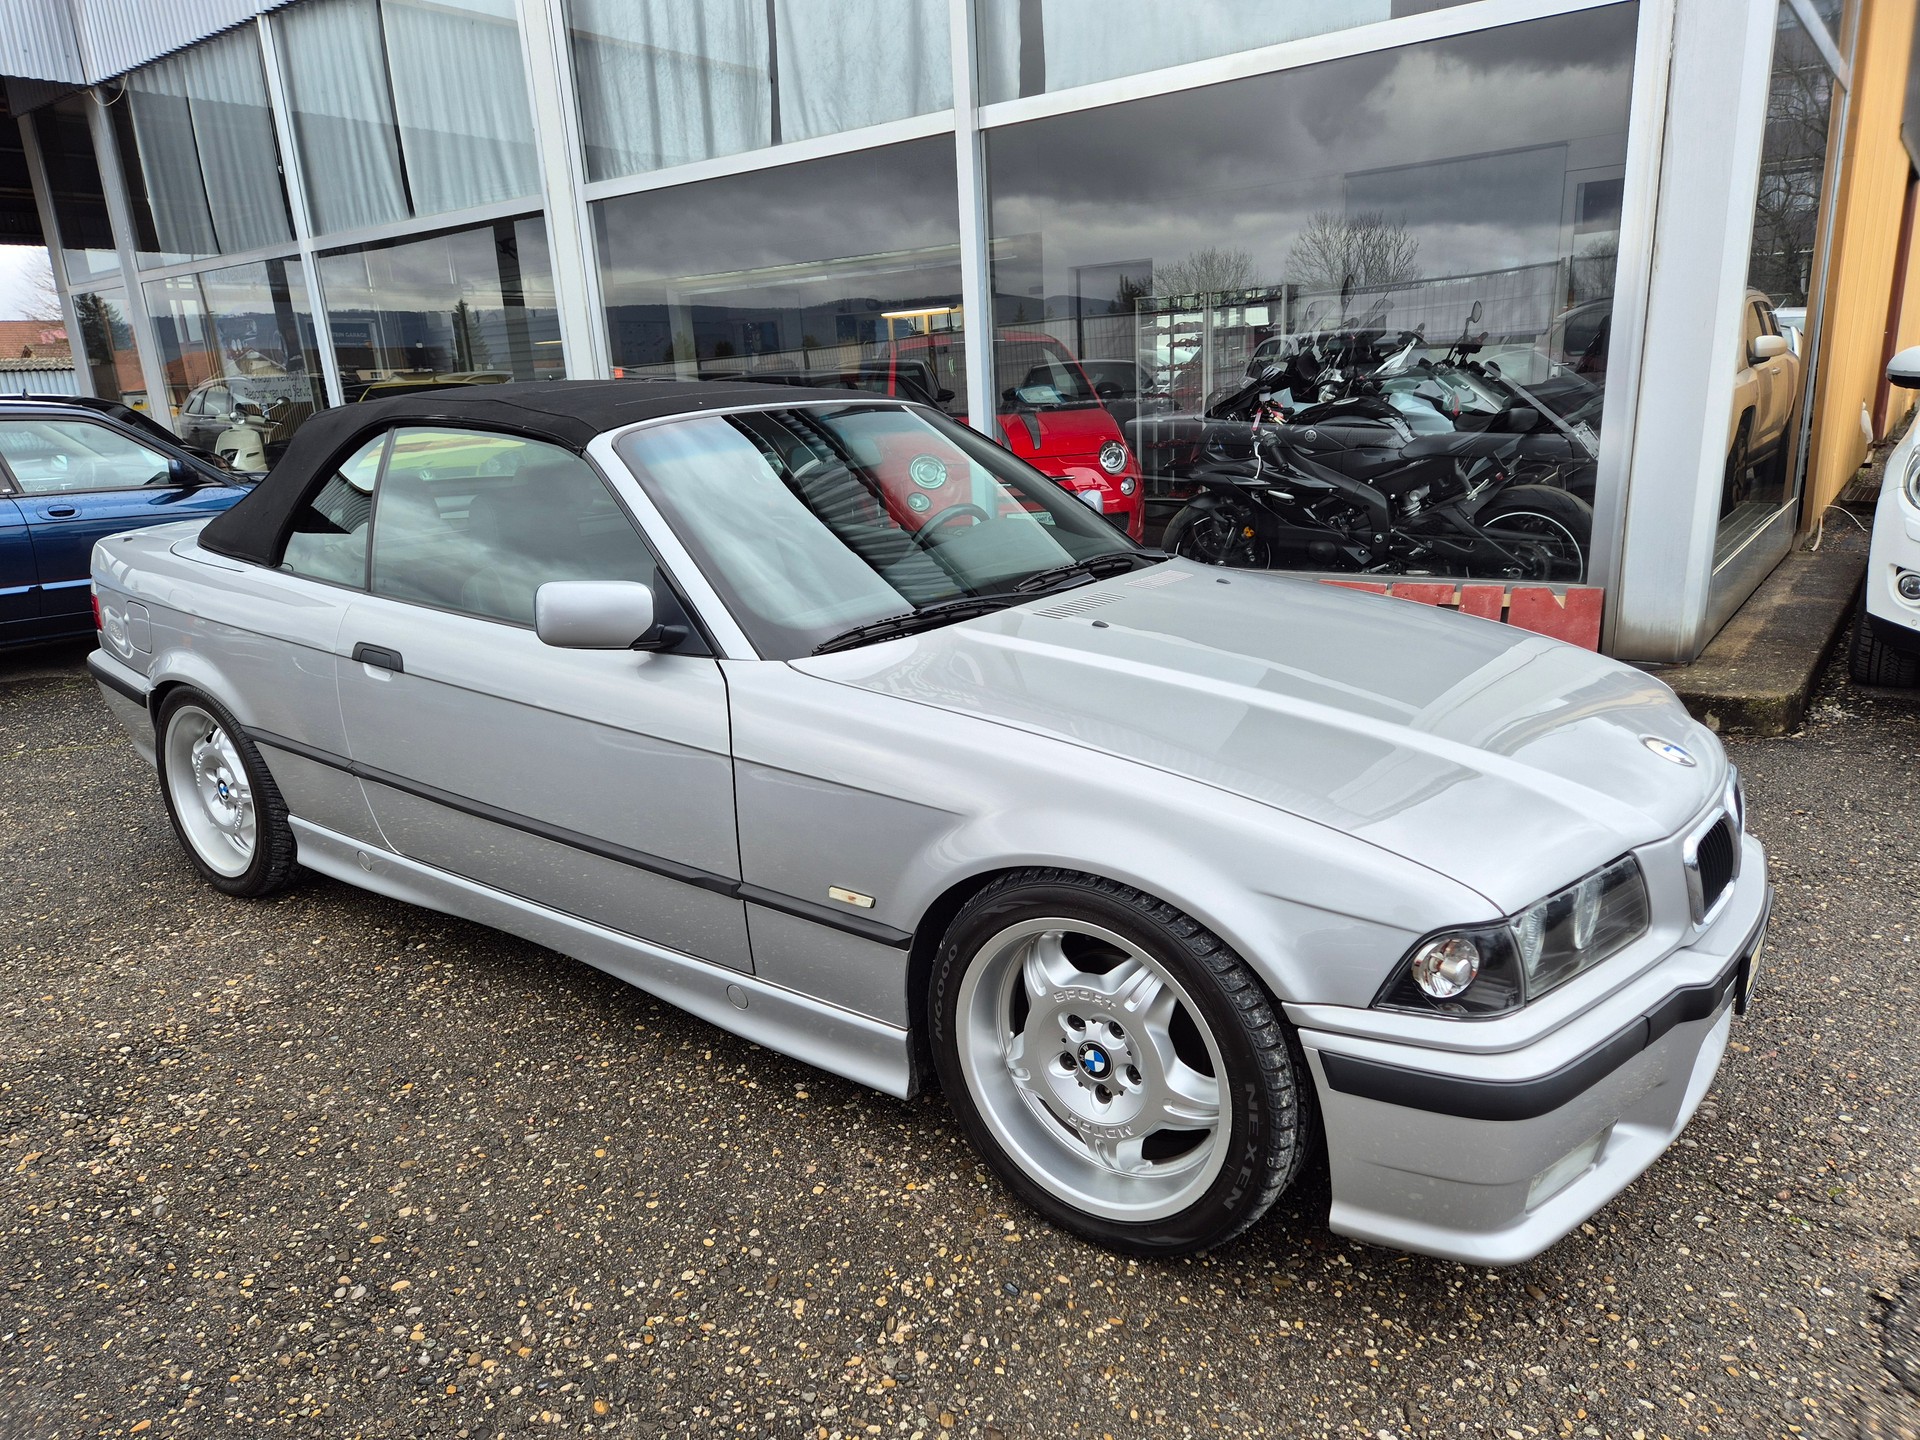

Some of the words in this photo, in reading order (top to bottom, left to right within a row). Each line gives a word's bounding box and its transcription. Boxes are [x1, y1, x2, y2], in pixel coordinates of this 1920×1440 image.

[935, 943, 958, 1043] N6000
[1053, 988, 1117, 1011] SPORT
[1066, 1112, 1134, 1139] MOTOR
[1223, 1083, 1259, 1210] NEXEN
